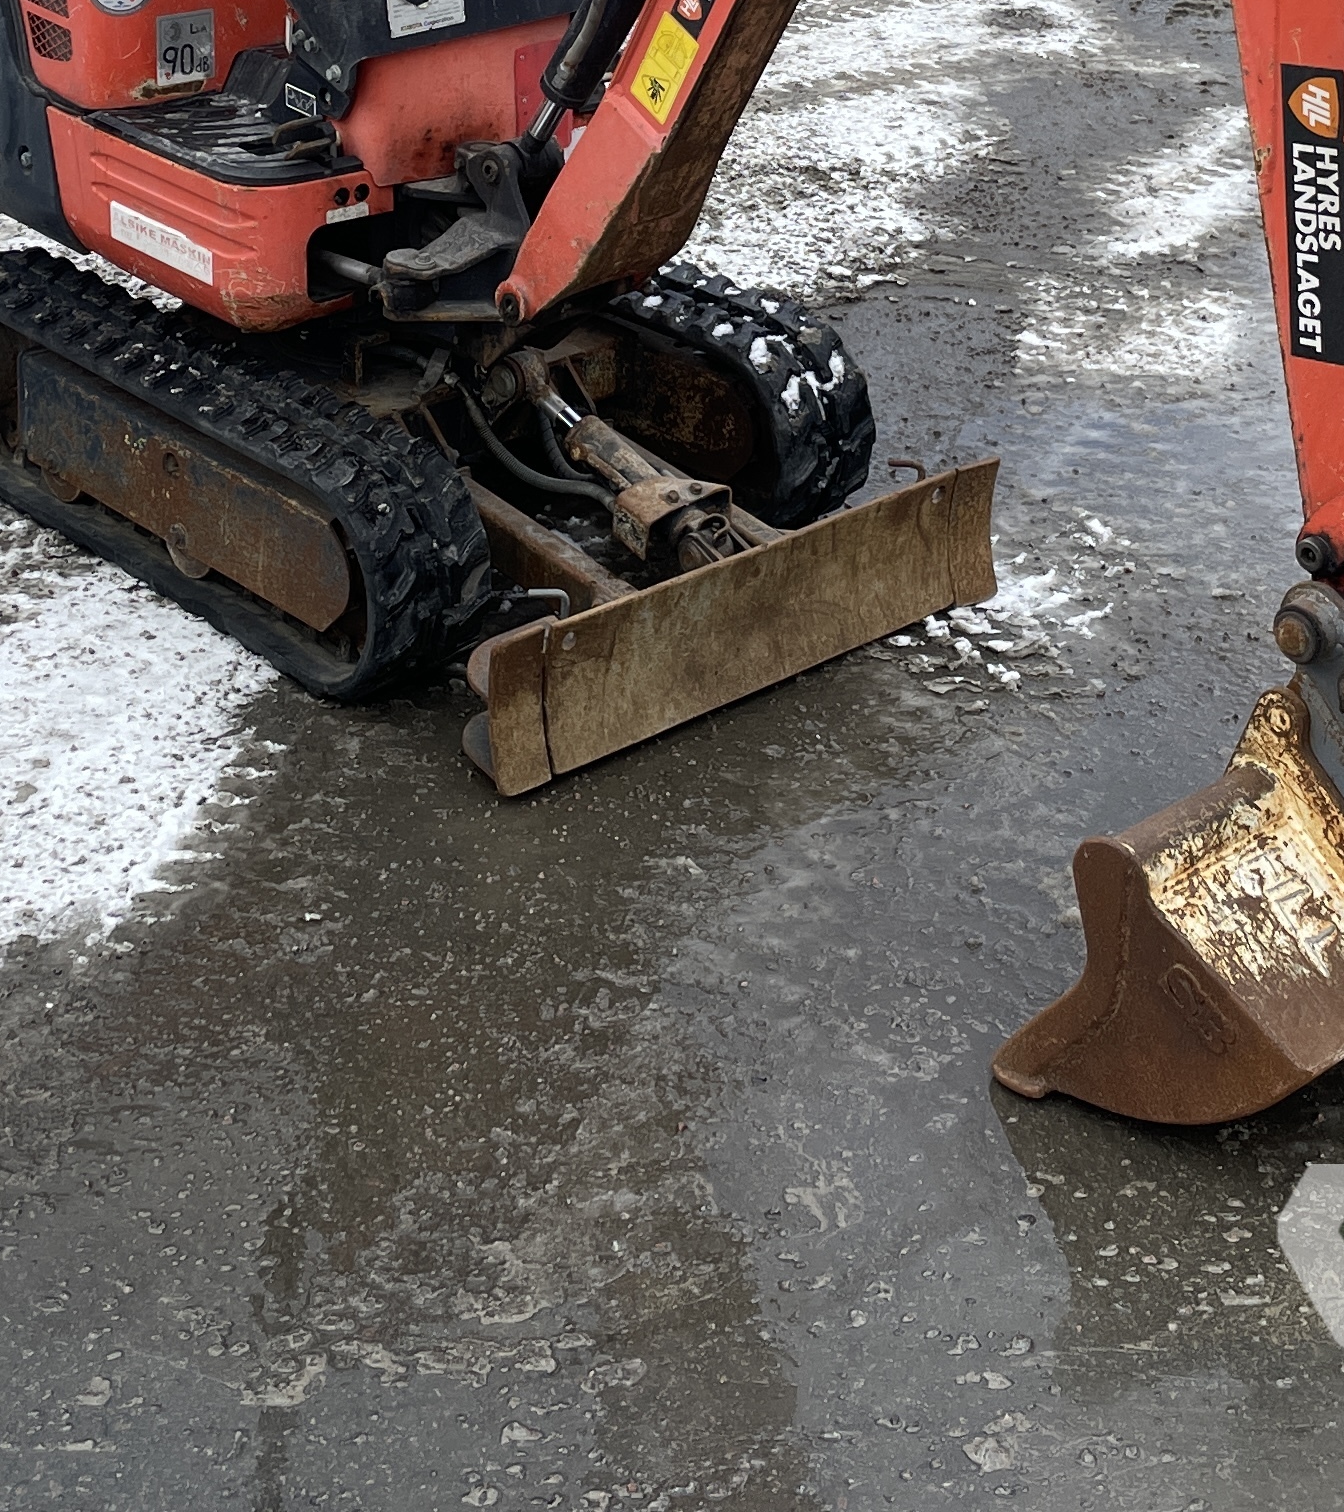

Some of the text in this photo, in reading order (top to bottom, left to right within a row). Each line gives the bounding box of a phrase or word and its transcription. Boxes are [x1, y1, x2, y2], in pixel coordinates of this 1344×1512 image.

[160, 232, 212, 266] MASKIN
[1292, 142, 1323, 354] LANDSLAGET
[1315, 145, 1342, 251] HYRES
